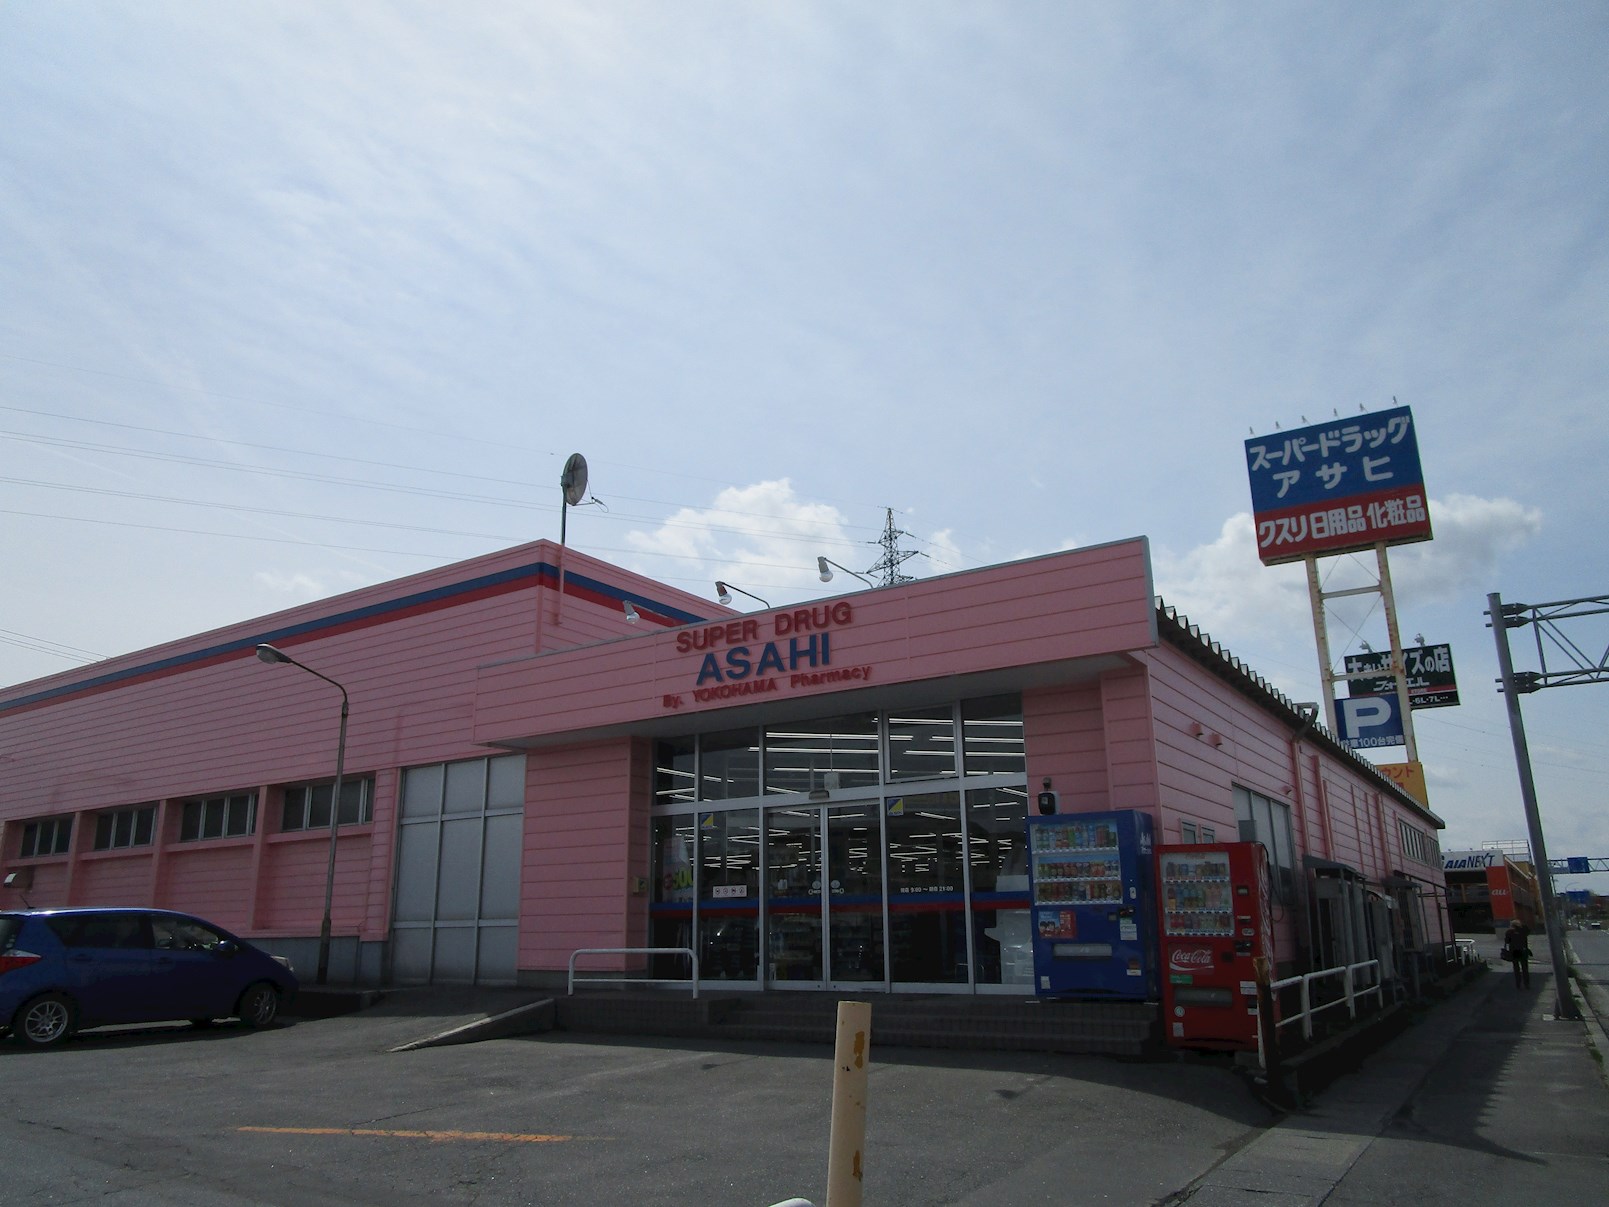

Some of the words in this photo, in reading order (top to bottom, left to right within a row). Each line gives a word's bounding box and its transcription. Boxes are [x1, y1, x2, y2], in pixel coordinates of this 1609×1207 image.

[1249, 415, 1410, 472] スーパードラッグ
[1258, 517, 1309, 548] クスリ
[1309, 507, 1367, 540] 日用品
[1366, 494, 1426, 530] 化粧品
[676, 619, 759, 654] SUPER
[774, 601, 854, 637] DRUG
[692, 677, 778, 703] YOKOHAMA
[790, 665, 873, 689] Pharmacy
[696, 632, 831, 686] ASAHI
[1343, 697, 1392, 739] P
